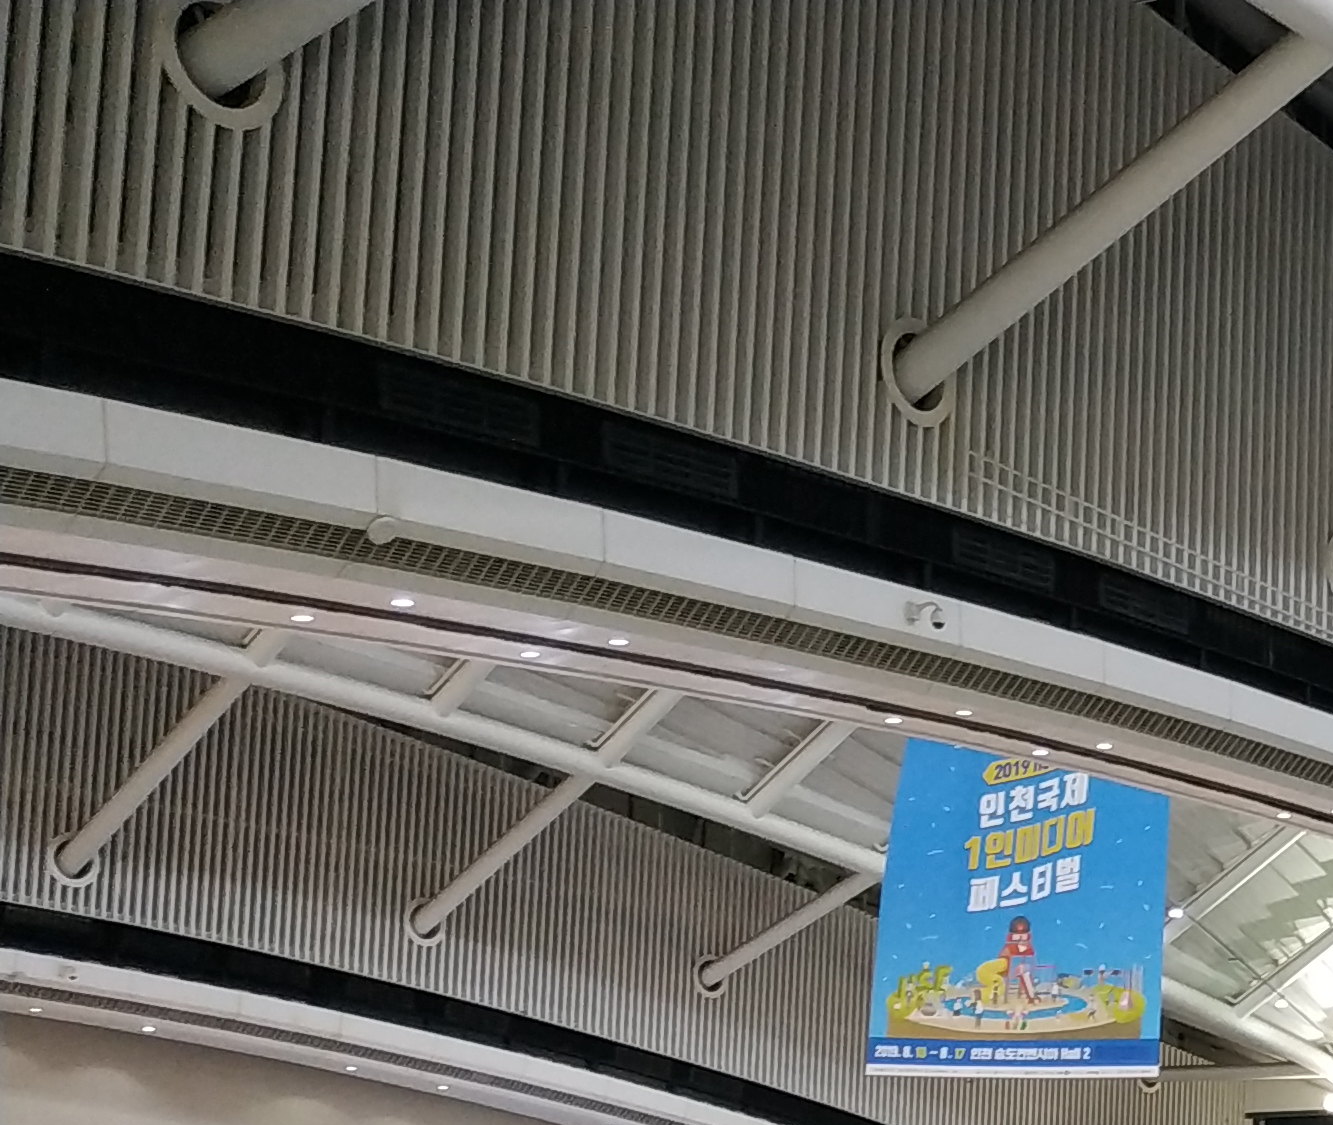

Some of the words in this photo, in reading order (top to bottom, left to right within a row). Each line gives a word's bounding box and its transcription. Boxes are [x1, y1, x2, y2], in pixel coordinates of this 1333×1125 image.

[993, 760, 1029, 781] 2019
[979, 773, 1090, 828] 인천국제
[964, 807, 1096, 870] 1인미디어
[967, 855, 1082, 912] 페스티벌
